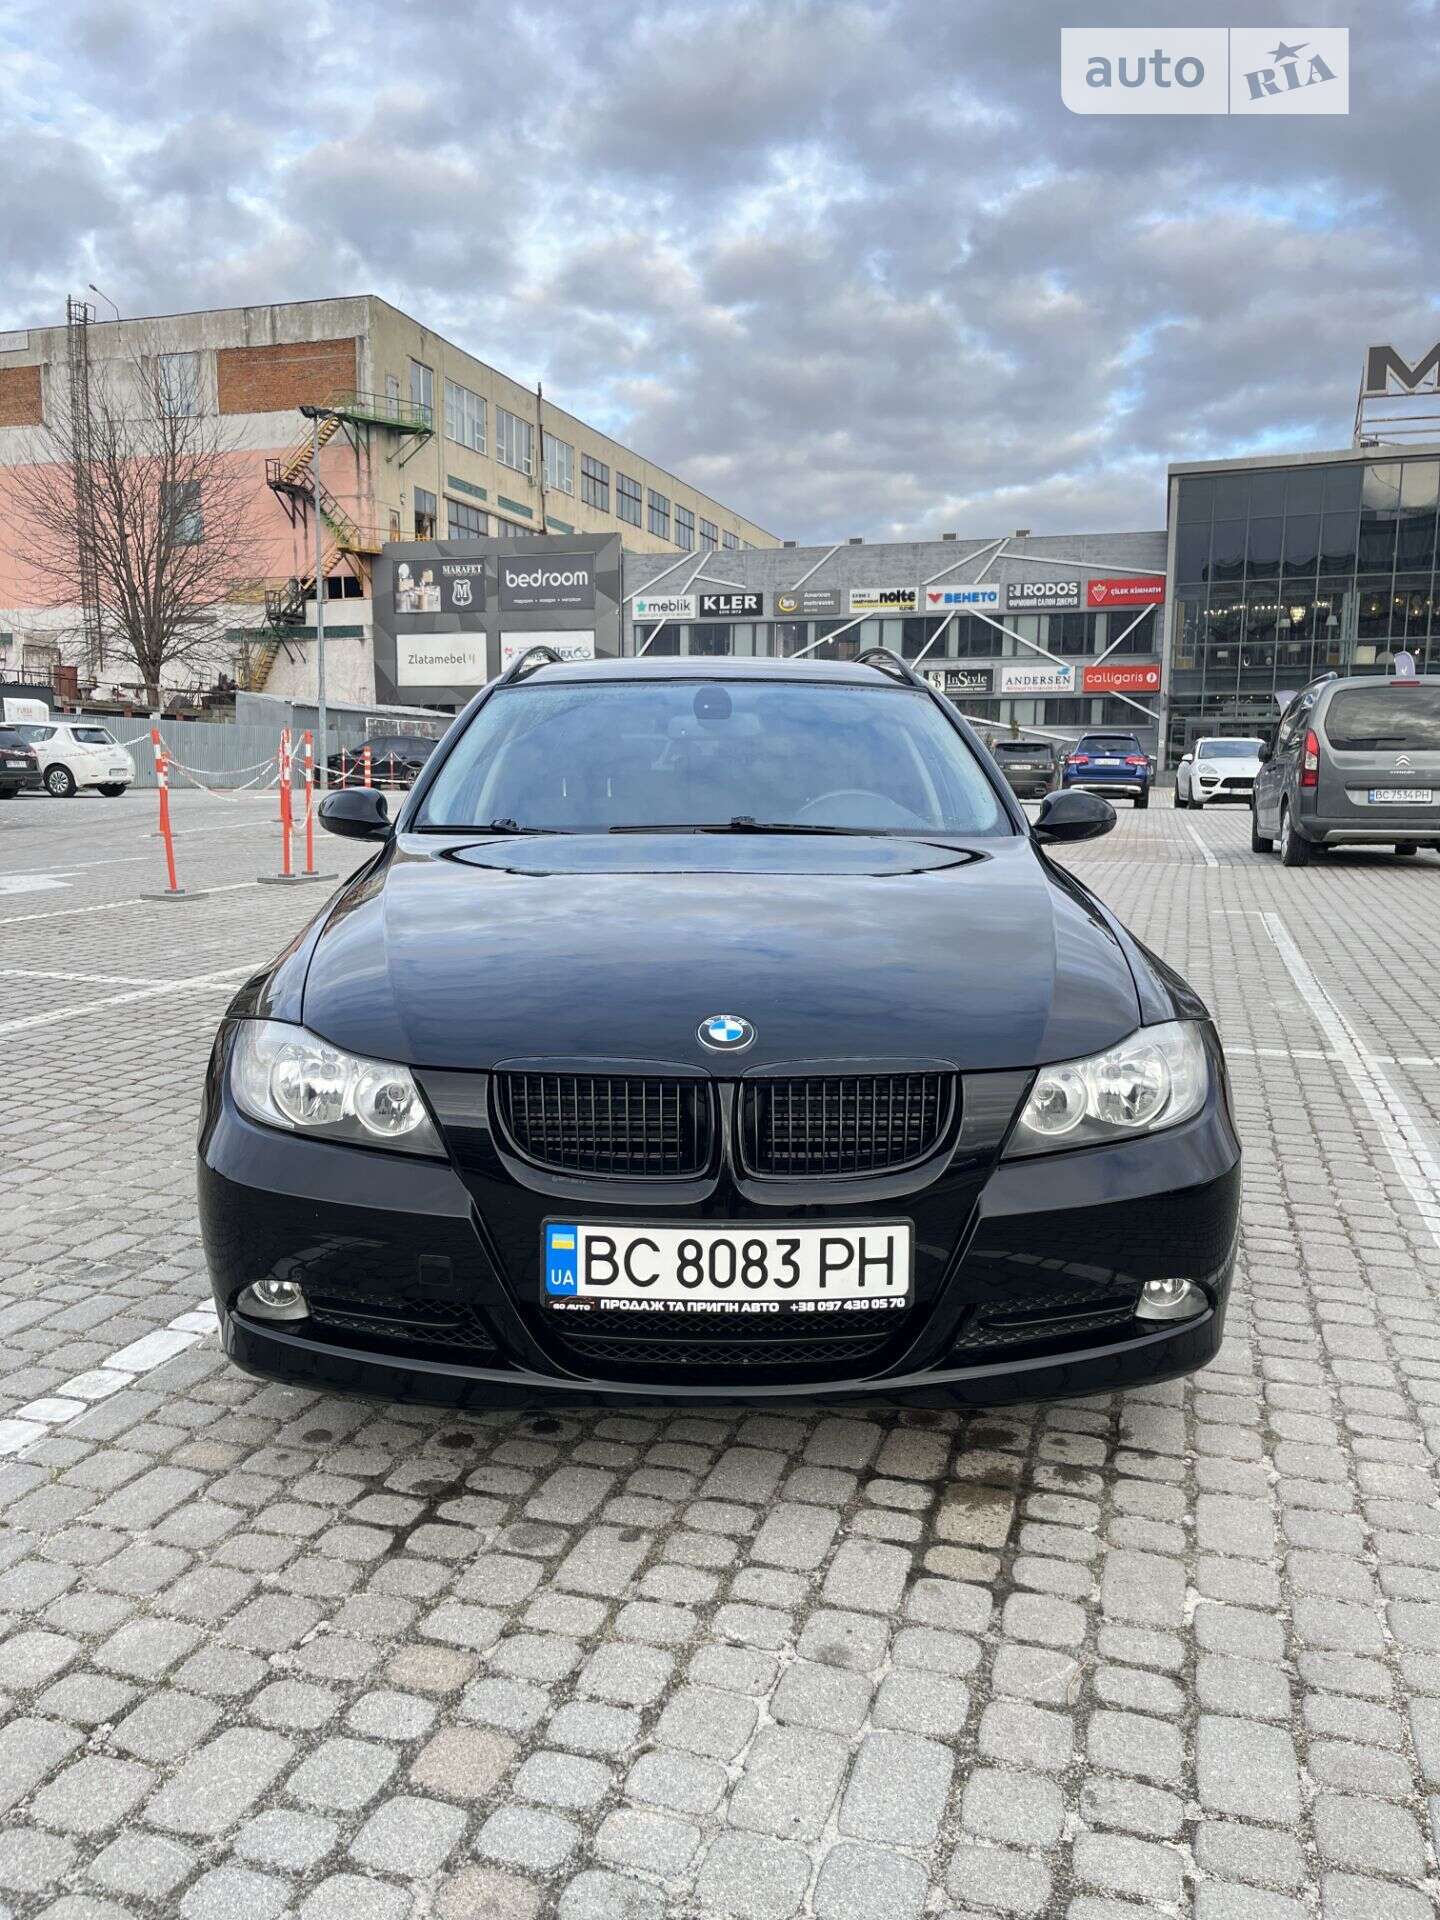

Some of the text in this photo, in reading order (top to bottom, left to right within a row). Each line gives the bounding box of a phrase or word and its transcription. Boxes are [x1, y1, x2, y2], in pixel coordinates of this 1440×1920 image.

[442, 564, 482, 575] MARAFET
[506, 568, 588, 588] bedroom
[880, 589, 915, 604] nolte
[1024, 582, 1077, 596] RODOS
[703, 595, 758, 611] KLER
[944, 591, 997, 604] ВЕНЕТО
[648, 598, 691, 613] meblik
[408, 653, 467, 665] Zlatamebel
[947, 671, 988, 687] InStyle
[1006, 675, 1072, 685] ANDERSEN
[1086, 672, 1144, 685] calligaris
[584, 1235, 894, 1289] BC 8083 PH
[551, 1269, 574, 1286] UA
[567, 1303, 591, 1311] AUTO
[600, 1297, 905, 1313] ПРОДАЖ ТА ПРИГІН АВТО +38 097 430 05 70
